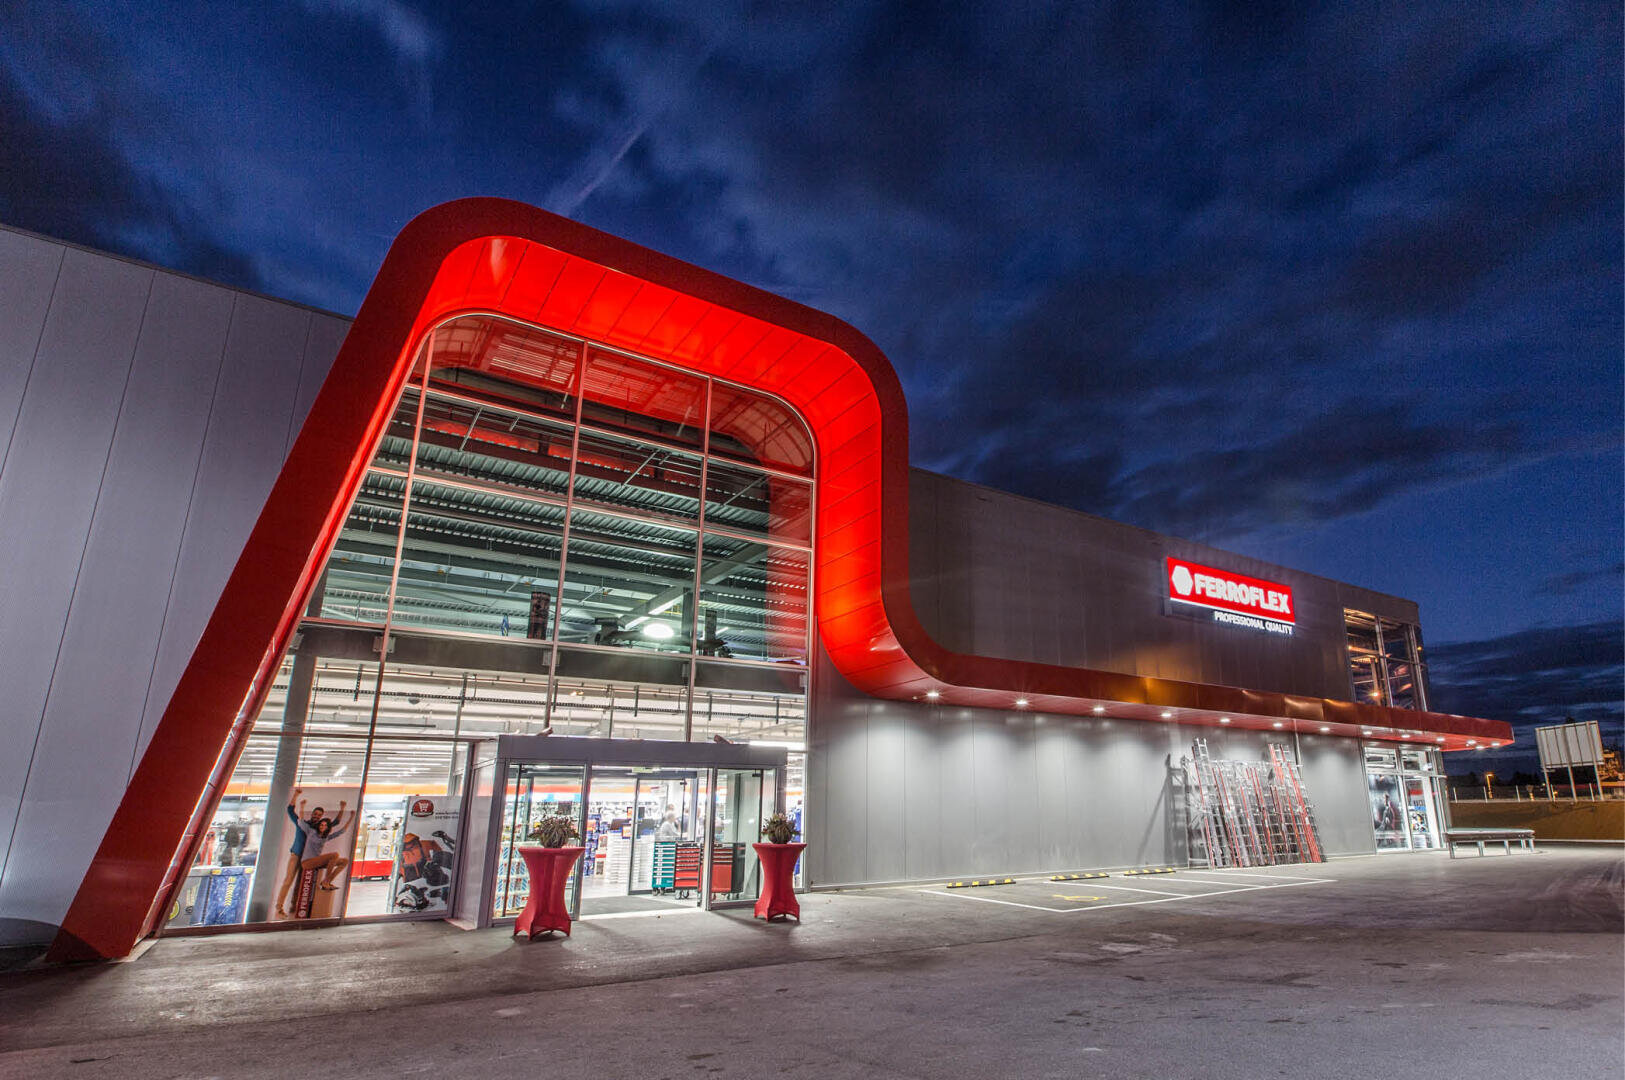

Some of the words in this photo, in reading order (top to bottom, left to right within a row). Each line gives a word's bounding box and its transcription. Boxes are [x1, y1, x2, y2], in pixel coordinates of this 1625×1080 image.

[1194, 573, 1290, 614] FERROFLEX
[1214, 611, 1265, 630] PROFESSIONAL
[1265, 621, 1293, 635] QUALITY
[300, 870, 313, 909] FERROFLEX
